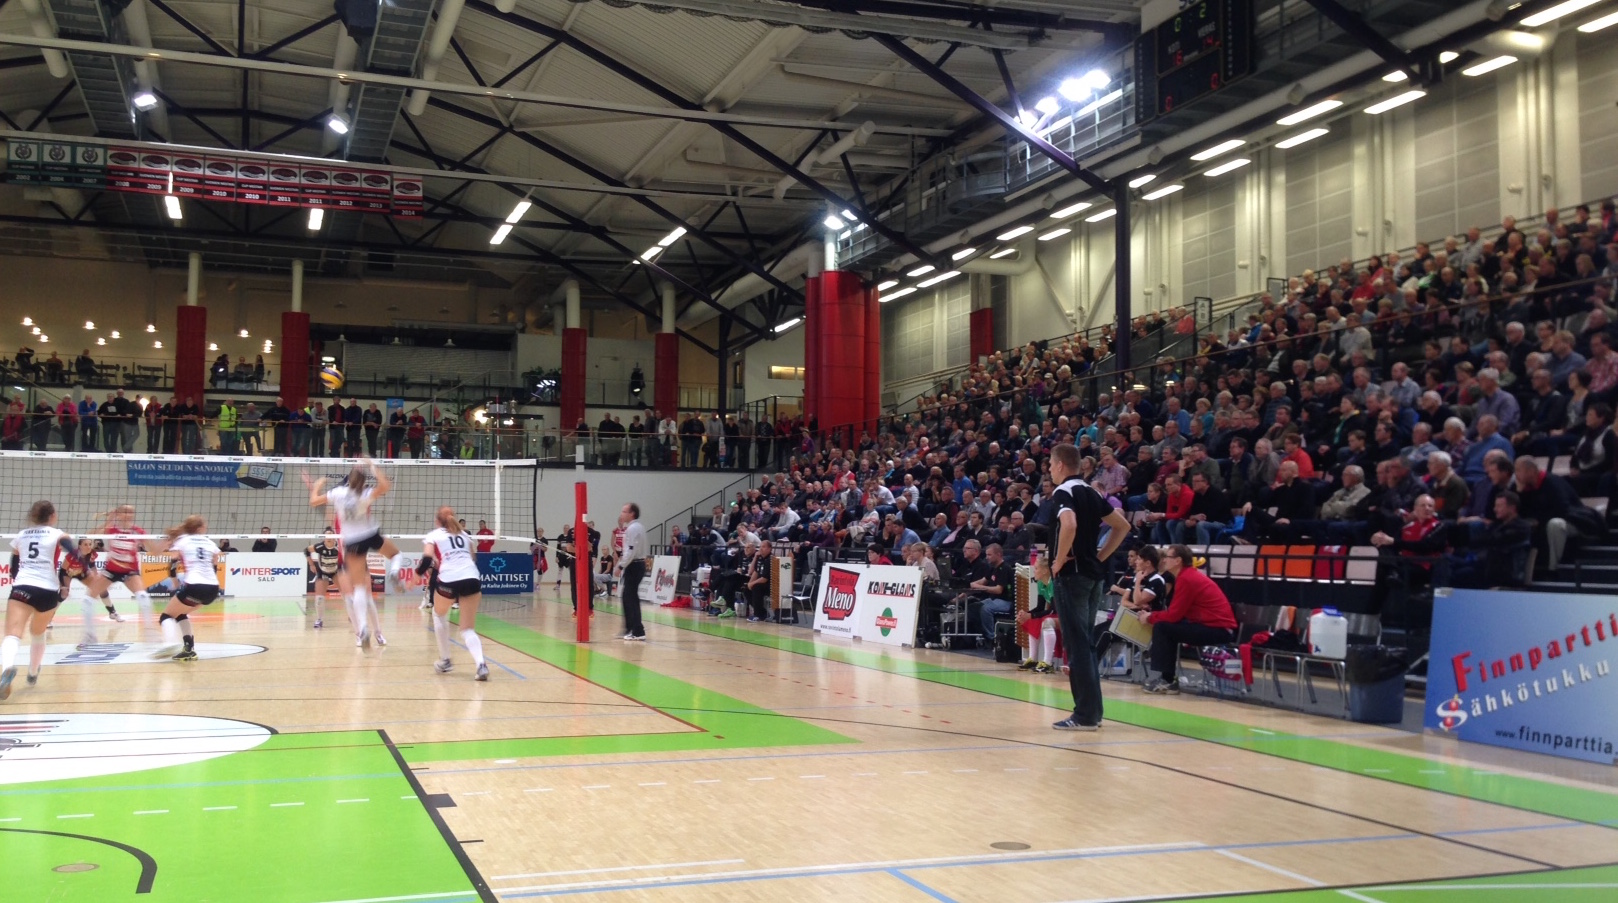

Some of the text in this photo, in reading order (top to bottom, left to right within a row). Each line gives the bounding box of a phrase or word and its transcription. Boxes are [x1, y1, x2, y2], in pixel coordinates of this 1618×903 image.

[1199, 2, 1207, 18] 2
[1174, 17, 1182, 32] 0
[128, 463, 235, 474] SALON SEUDUN SANOMAT
[448, 535, 465, 549] 10
[28, 542, 40, 559] 5
[242, 567, 301, 576] INTERSPORT
[825, 587, 853, 611] Meno
[1436, 659, 1610, 732] Sähkötukku
